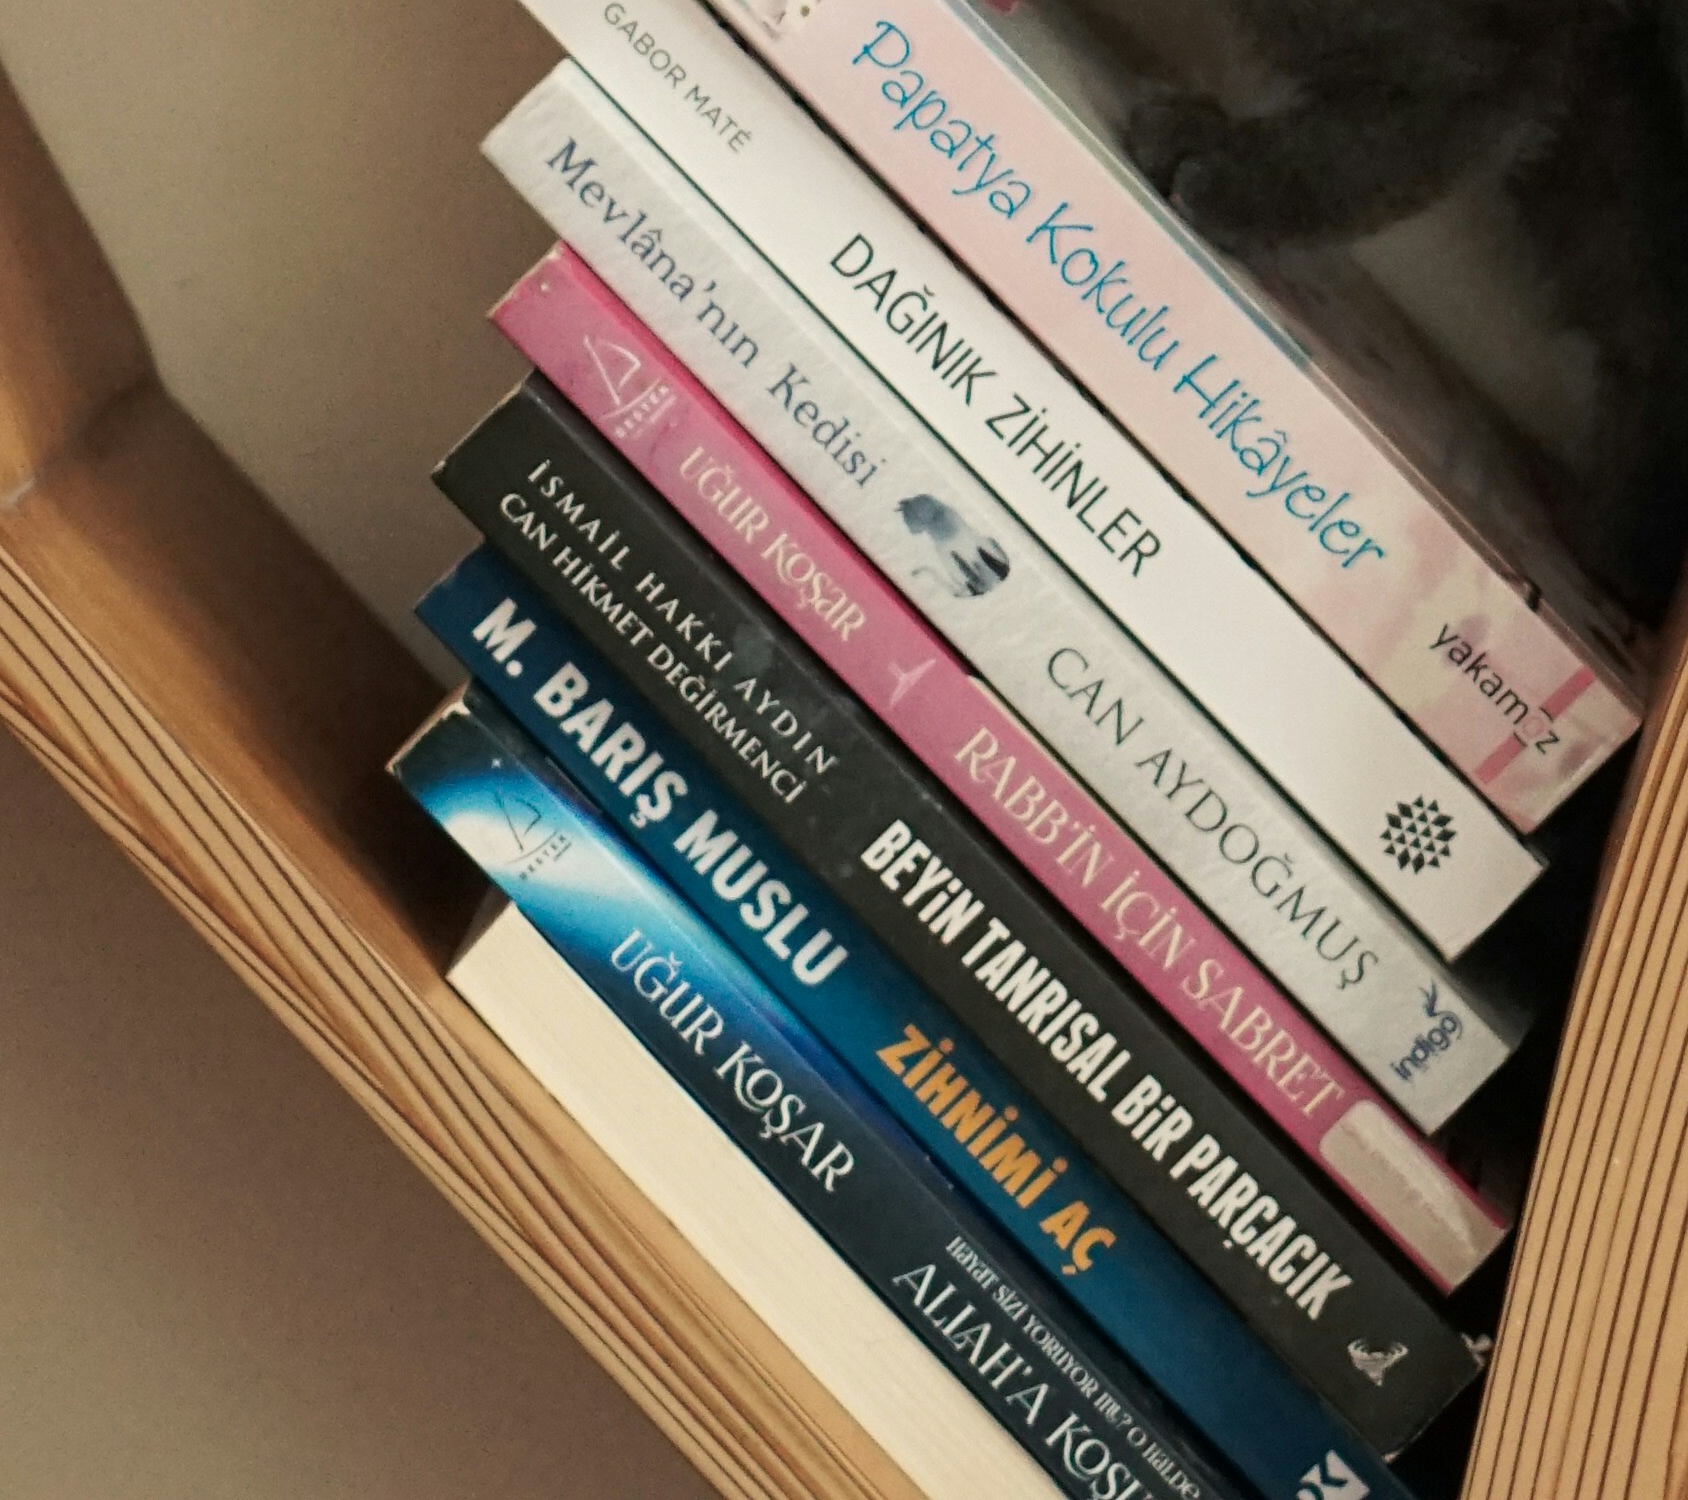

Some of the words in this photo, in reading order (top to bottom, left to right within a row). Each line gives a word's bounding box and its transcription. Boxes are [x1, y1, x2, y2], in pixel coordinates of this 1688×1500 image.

[604, 2, 687, 89] GABOR
[685, 84, 752, 153] MATÉ
[546, 136, 760, 368] Mevlâna'nın
[768, 362, 889, 489] Kedisi
[830, 233, 997, 407] DAĞINIK
[985, 392, 1161, 578] ZİHİNLER
[852, 21, 1032, 218] Papatya
[1026, 202, 1182, 372] Kokulu
[1173, 354, 1386, 569] Hikâyeler
[527, 459, 637, 573] İSMAİL
[635, 571, 735, 672] HAKKI
[733, 677, 839, 776] AYDIN
[680, 445, 772, 543] UĞUR
[500, 493, 559, 552] CAN
[552, 545, 655, 648] HİKMET
[647, 641, 809, 804] DEĞİRMENCİ
[472, 597, 537, 678] M.
[533, 661, 690, 830] BARIŞ
[673, 808, 850, 989] MUSLU
[1048, 647, 1145, 747] CAN
[1136, 748, 1380, 990] AYDOĞMUŞ
[611, 928, 726, 1056] UĞUR
[715, 1040, 857, 1194] KOŞAR
[960, 917, 1132, 1102] TANRISAL
[1169, 1135, 1355, 1321] PARÇACIK
[1099, 870, 1197, 972] İÇİN
[1181, 959, 1346, 1119] SABRET
[1391, 1013, 1460, 1082] indigo
[892, 1264, 1048, 1426] ALLAH'A
[1022, 1315, 1099, 1398] YORUYOR
[1040, 1200, 1117, 1275] AÇ
